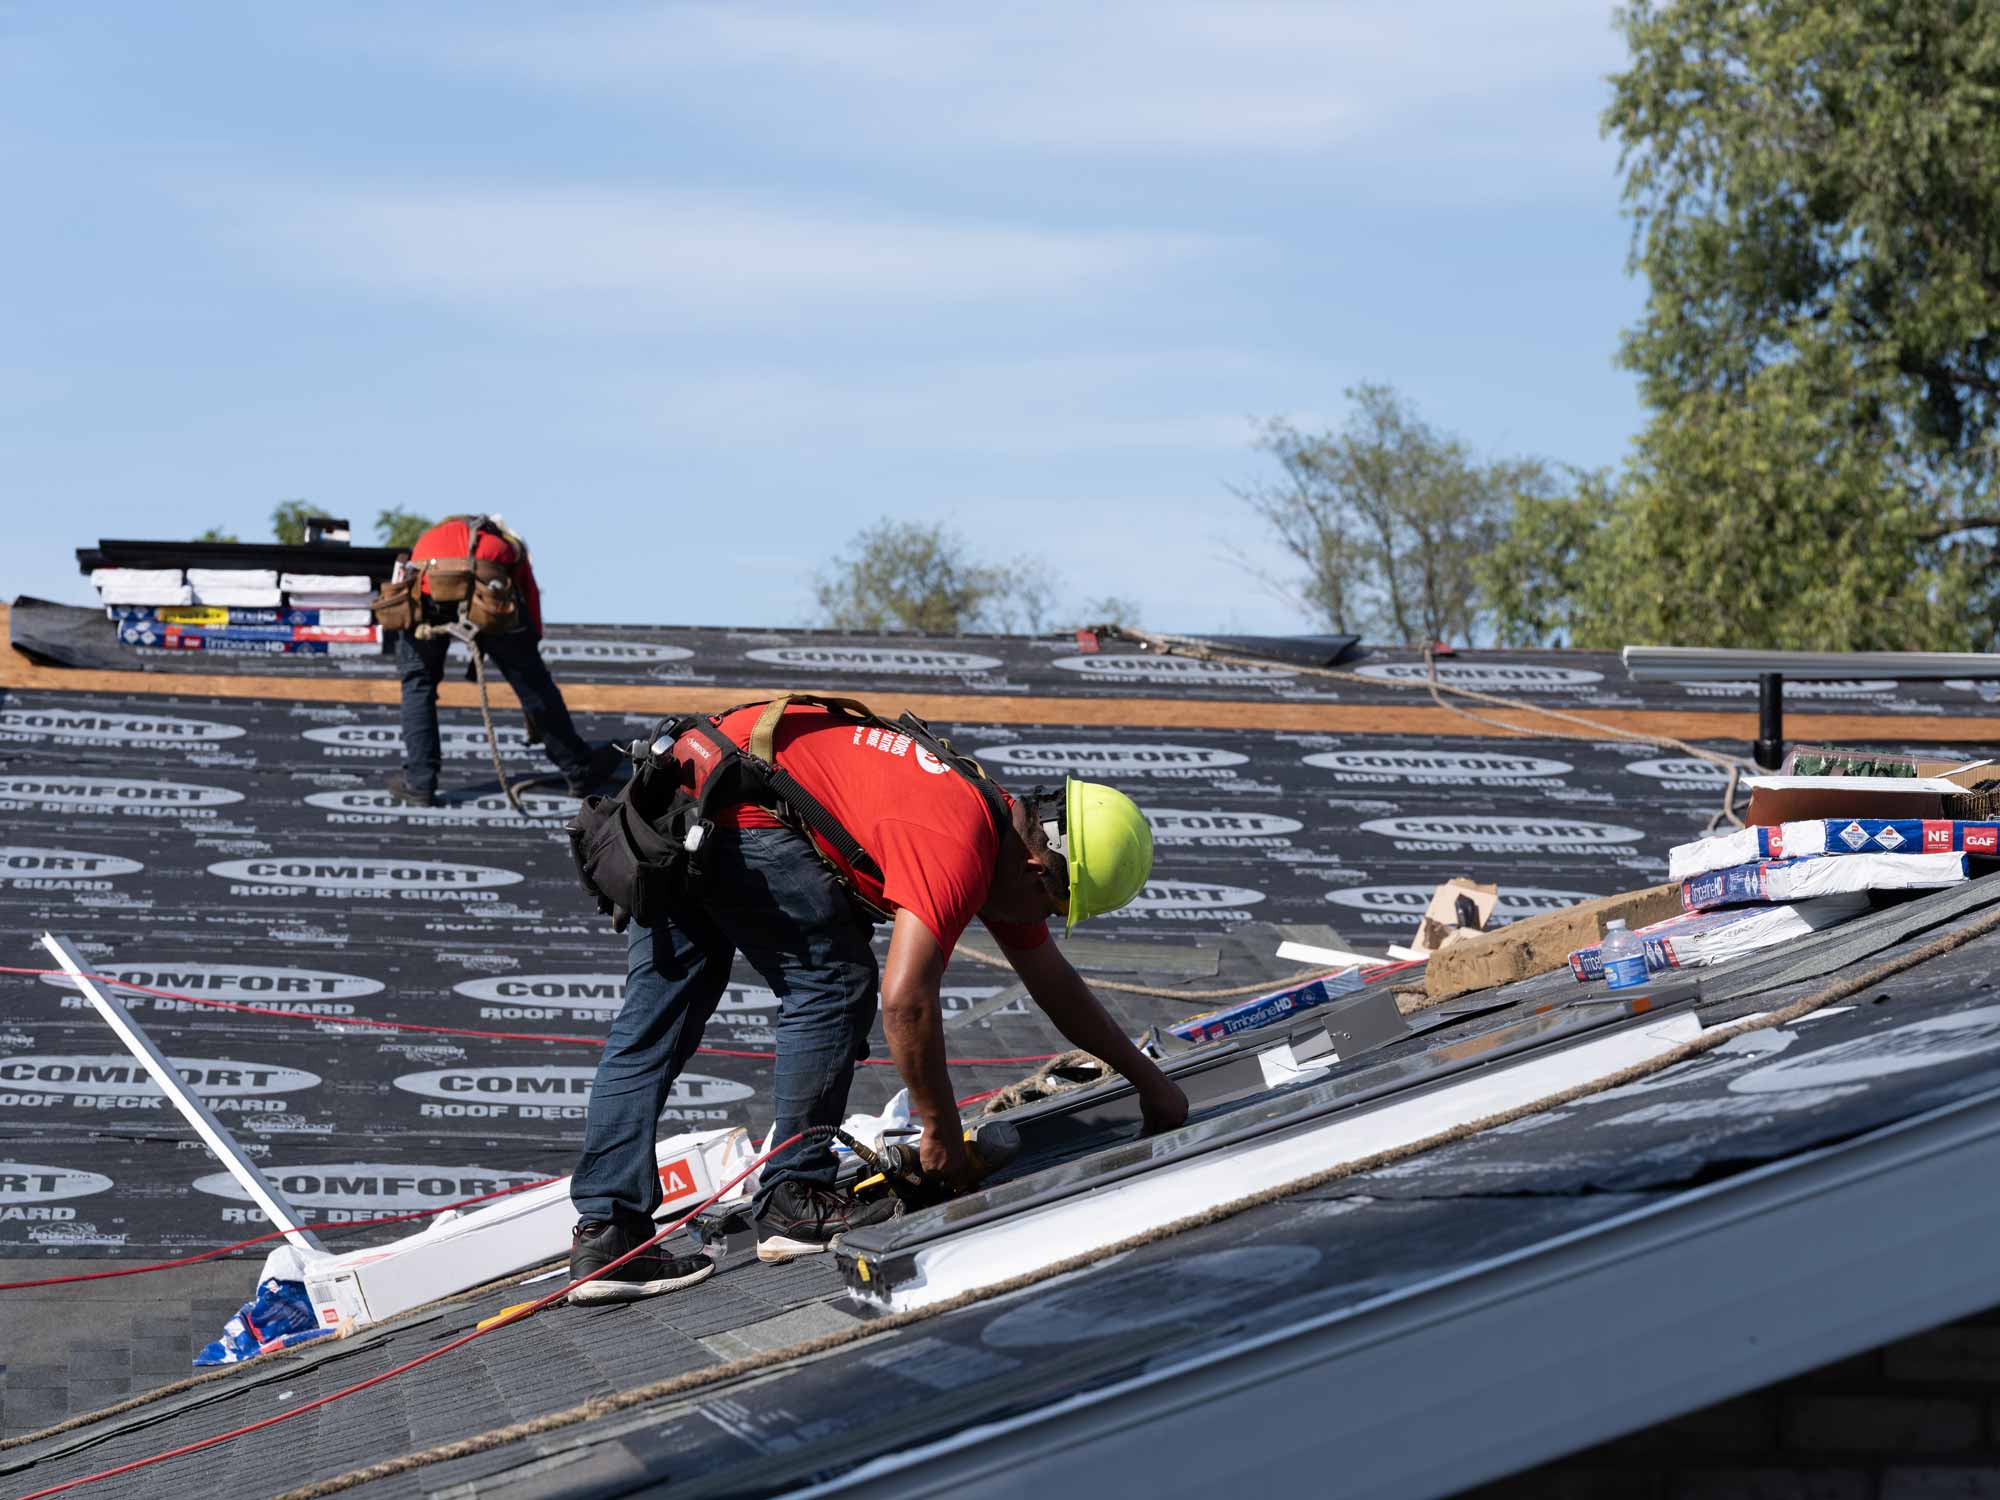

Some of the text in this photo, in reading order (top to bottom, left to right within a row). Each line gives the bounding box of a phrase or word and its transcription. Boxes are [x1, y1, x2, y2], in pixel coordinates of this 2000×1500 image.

[778, 651, 970, 665] COMFORT
[1084, 659, 1270, 673] COMFORT
[0, 713, 212, 736] COMFORT
[0, 732, 220, 752] OOF DECK GUARD
[324, 747, 392, 758] ROOF
[1008, 749, 1214, 764] COMFORT
[1336, 755, 1539, 771] COMFORT
[1003, 765, 1237, 780] ROOF DECK GUARD
[1334, 772, 1566, 787] ROOF DECK GUARD
[0, 800, 218, 818] OF DECK GUARD
[327, 813, 570, 829] ROOF DECK GUAR
[1154, 816, 1267, 830] FORT
[1394, 822, 1608, 838] COMFORT
[1928, 831, 1950, 842] NE
[1200, 837, 1292, 848] GUARD
[1394, 841, 1638, 855] ROOF DECK GUARD
[1966, 836, 1996, 847] GAF
[247, 863, 488, 883] COMFORT
[13, 879, 113, 891] GUARD
[230, 885, 499, 901] ROOF DECK GUARD
[1156, 909, 1253, 921] GUARD
[1361, 912, 1424, 925] ROO
[60, 996, 356, 1015] ROF DECK GUARD
[480, 1006, 769, 1025] ROOF DE ARD
[0, 1093, 65, 1107] OOF
[73, 1095, 162, 1109] DECK
[420, 1103, 728, 1121] ROOF DEC ARD
[0, 1206, 78, 1222] ARD
[222, 1208, 317, 1223] ROF
